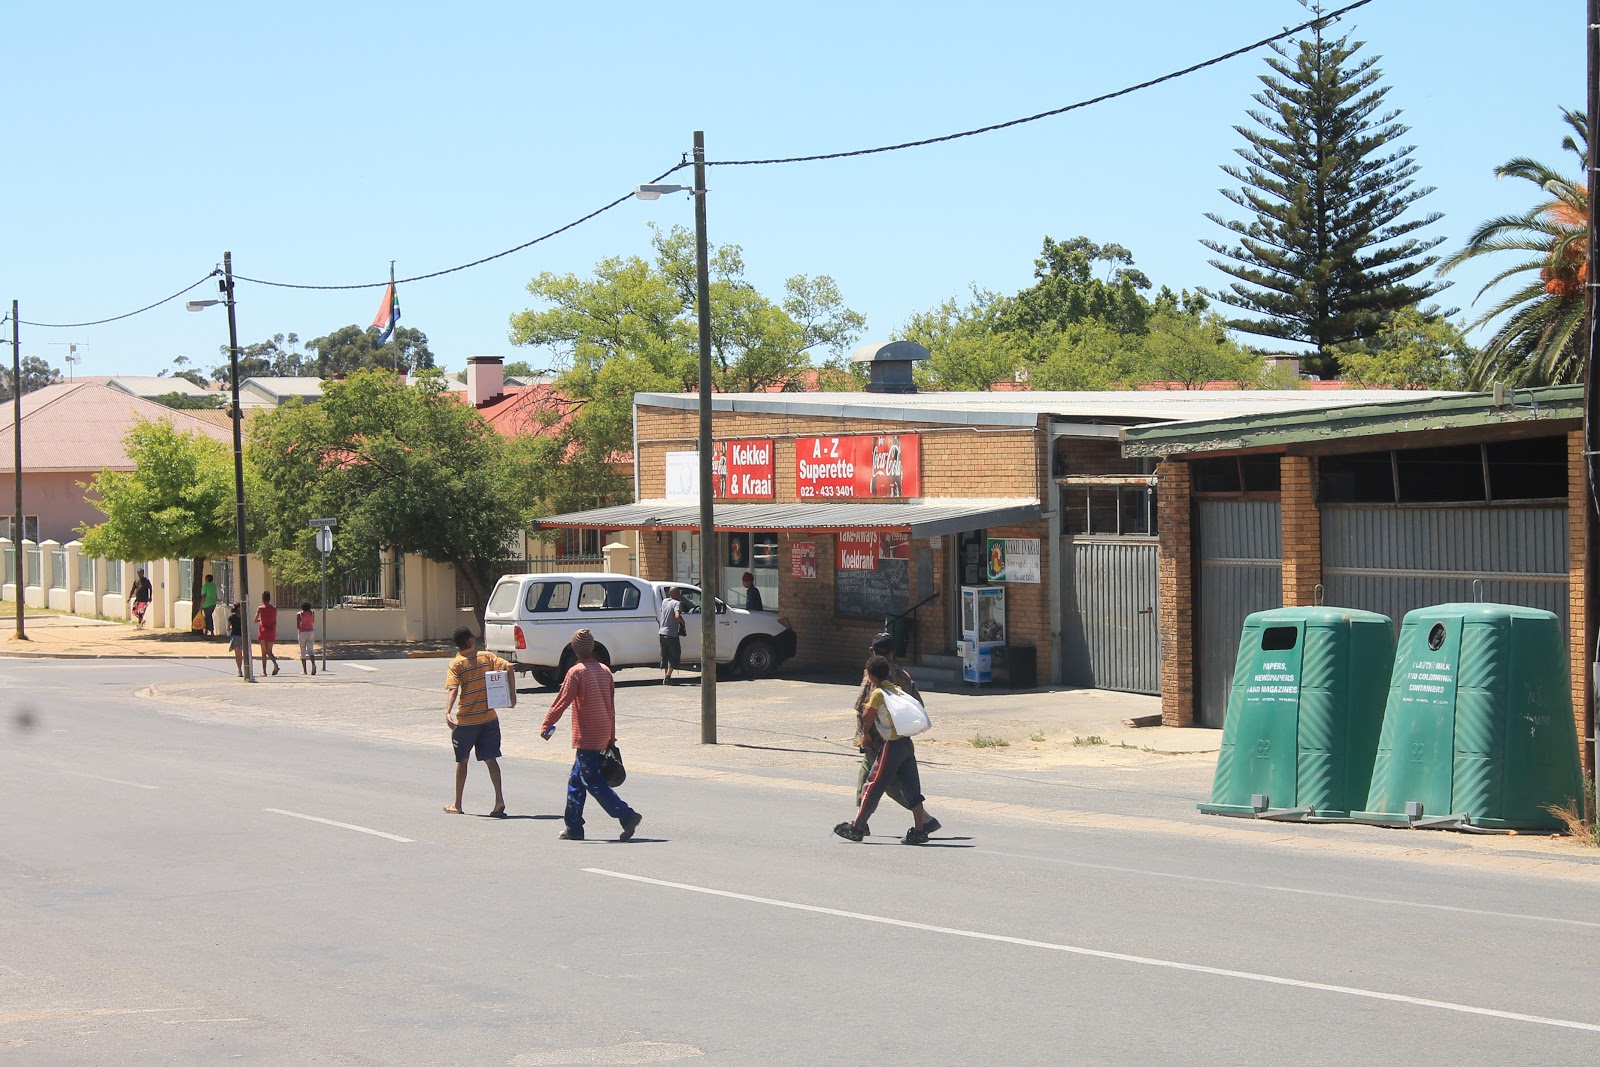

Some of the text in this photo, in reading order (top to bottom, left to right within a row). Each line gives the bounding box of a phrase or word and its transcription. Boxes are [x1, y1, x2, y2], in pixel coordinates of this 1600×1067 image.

[813, 438, 821, 458] A
[830, 438, 839, 458] Z
[732, 444, 769, 466] Kekkel
[799, 459, 854, 484] Superette
[731, 473, 772, 495] & Kraai
[800, 486, 814, 497] 022
[820, 486, 834, 497] 433
[835, 485, 854, 497] 3401
[841, 549, 875, 570] Koeldrank
[1262, 662, 1287, 671] PAPERS,
[490, 674, 501, 682] ELF
[1254, 674, 1295, 682] NEWSPAPERS
[1261, 685, 1298, 694] MAGAZINES
[1408, 684, 1445, 694] CONTAINERS
